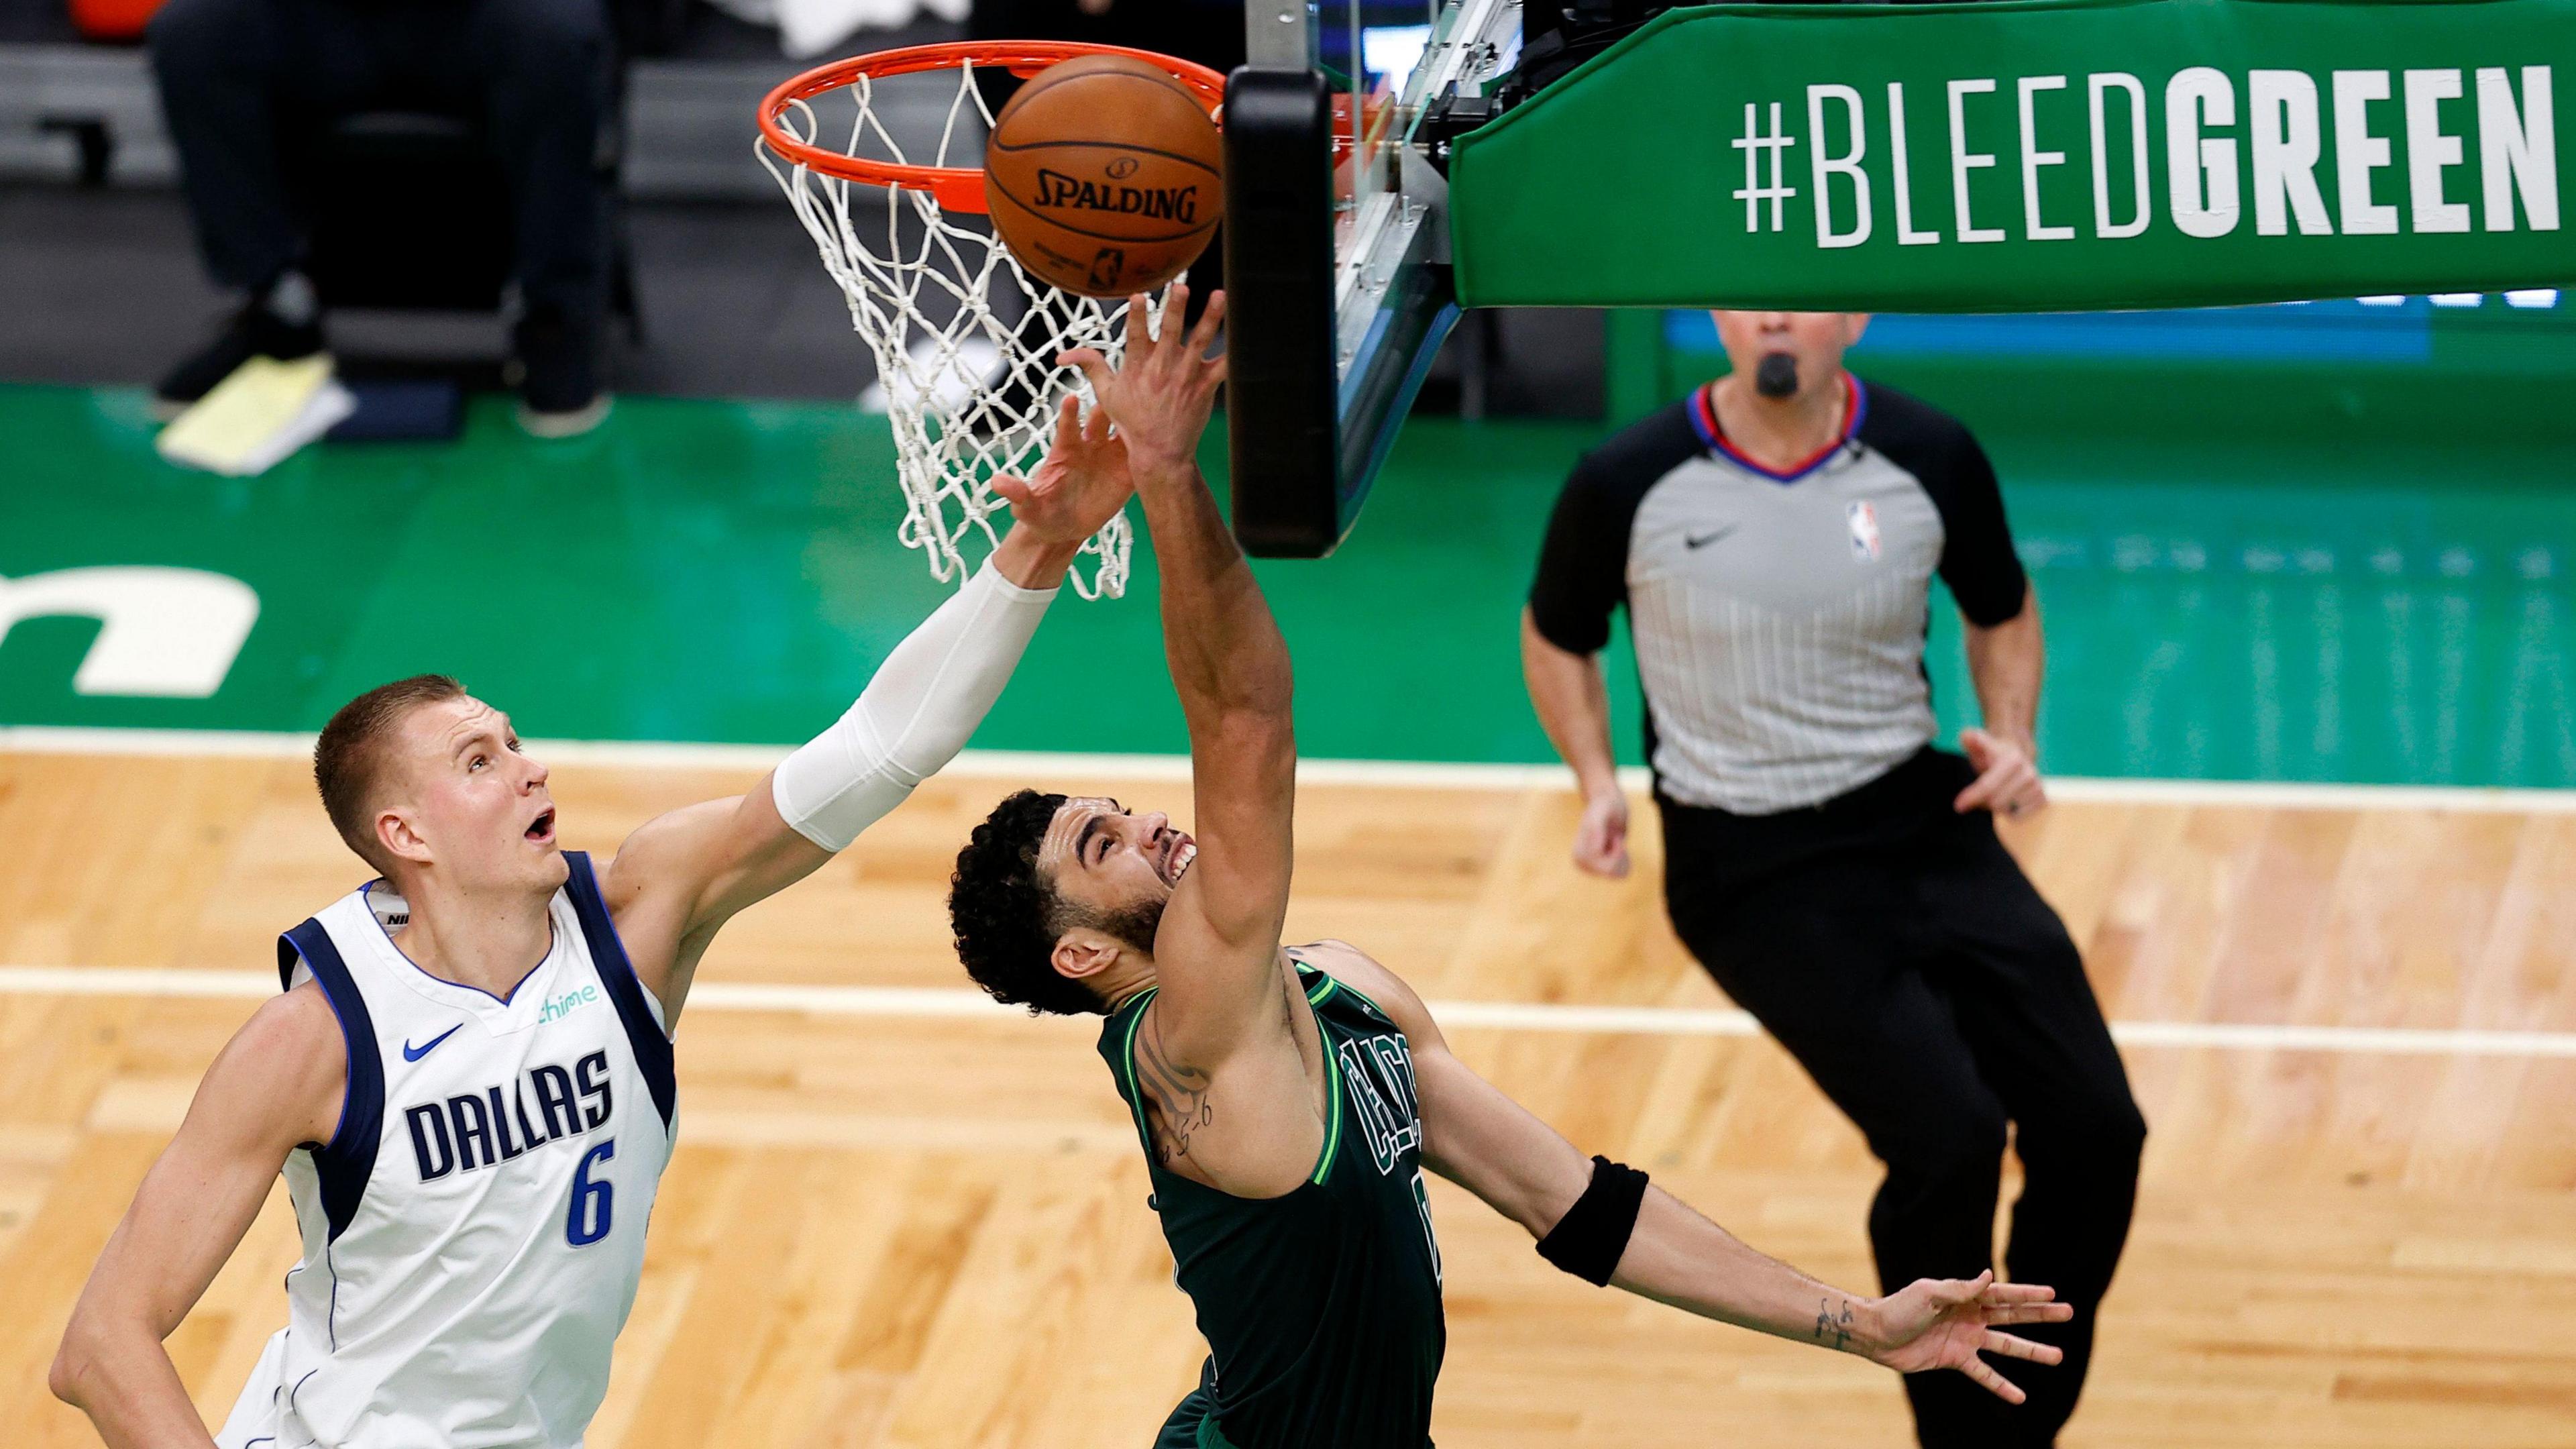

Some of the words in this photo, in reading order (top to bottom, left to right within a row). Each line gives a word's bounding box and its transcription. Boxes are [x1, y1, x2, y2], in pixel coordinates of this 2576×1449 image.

[1035, 168, 1197, 224] SPALDING
[1731, 64, 2561, 248] #BLEEDGREEN
[402, 1047, 614, 1185] DALLAS
[565, 1137, 615, 1248] 6
